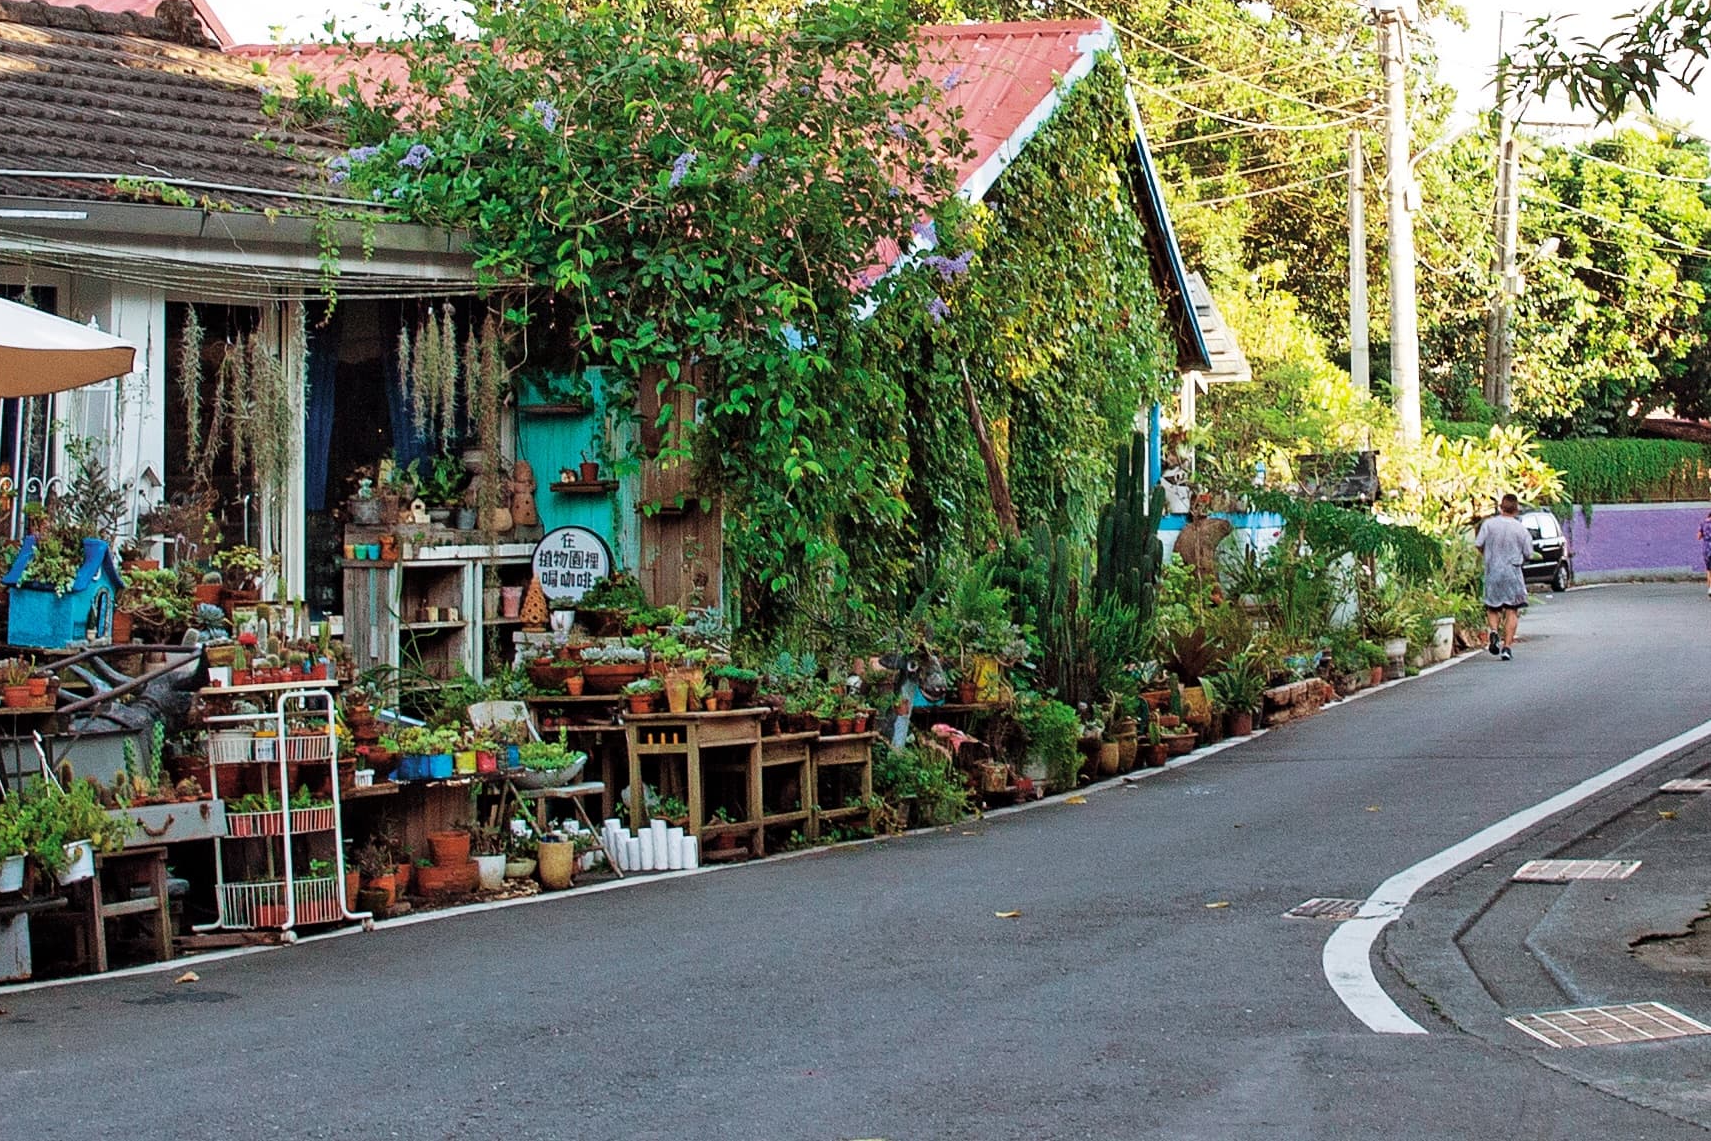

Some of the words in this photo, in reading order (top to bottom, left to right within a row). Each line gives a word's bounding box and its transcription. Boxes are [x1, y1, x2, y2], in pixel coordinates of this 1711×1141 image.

[561, 532, 576, 549] 在
[541, 570, 593, 588] 喝咖啡
